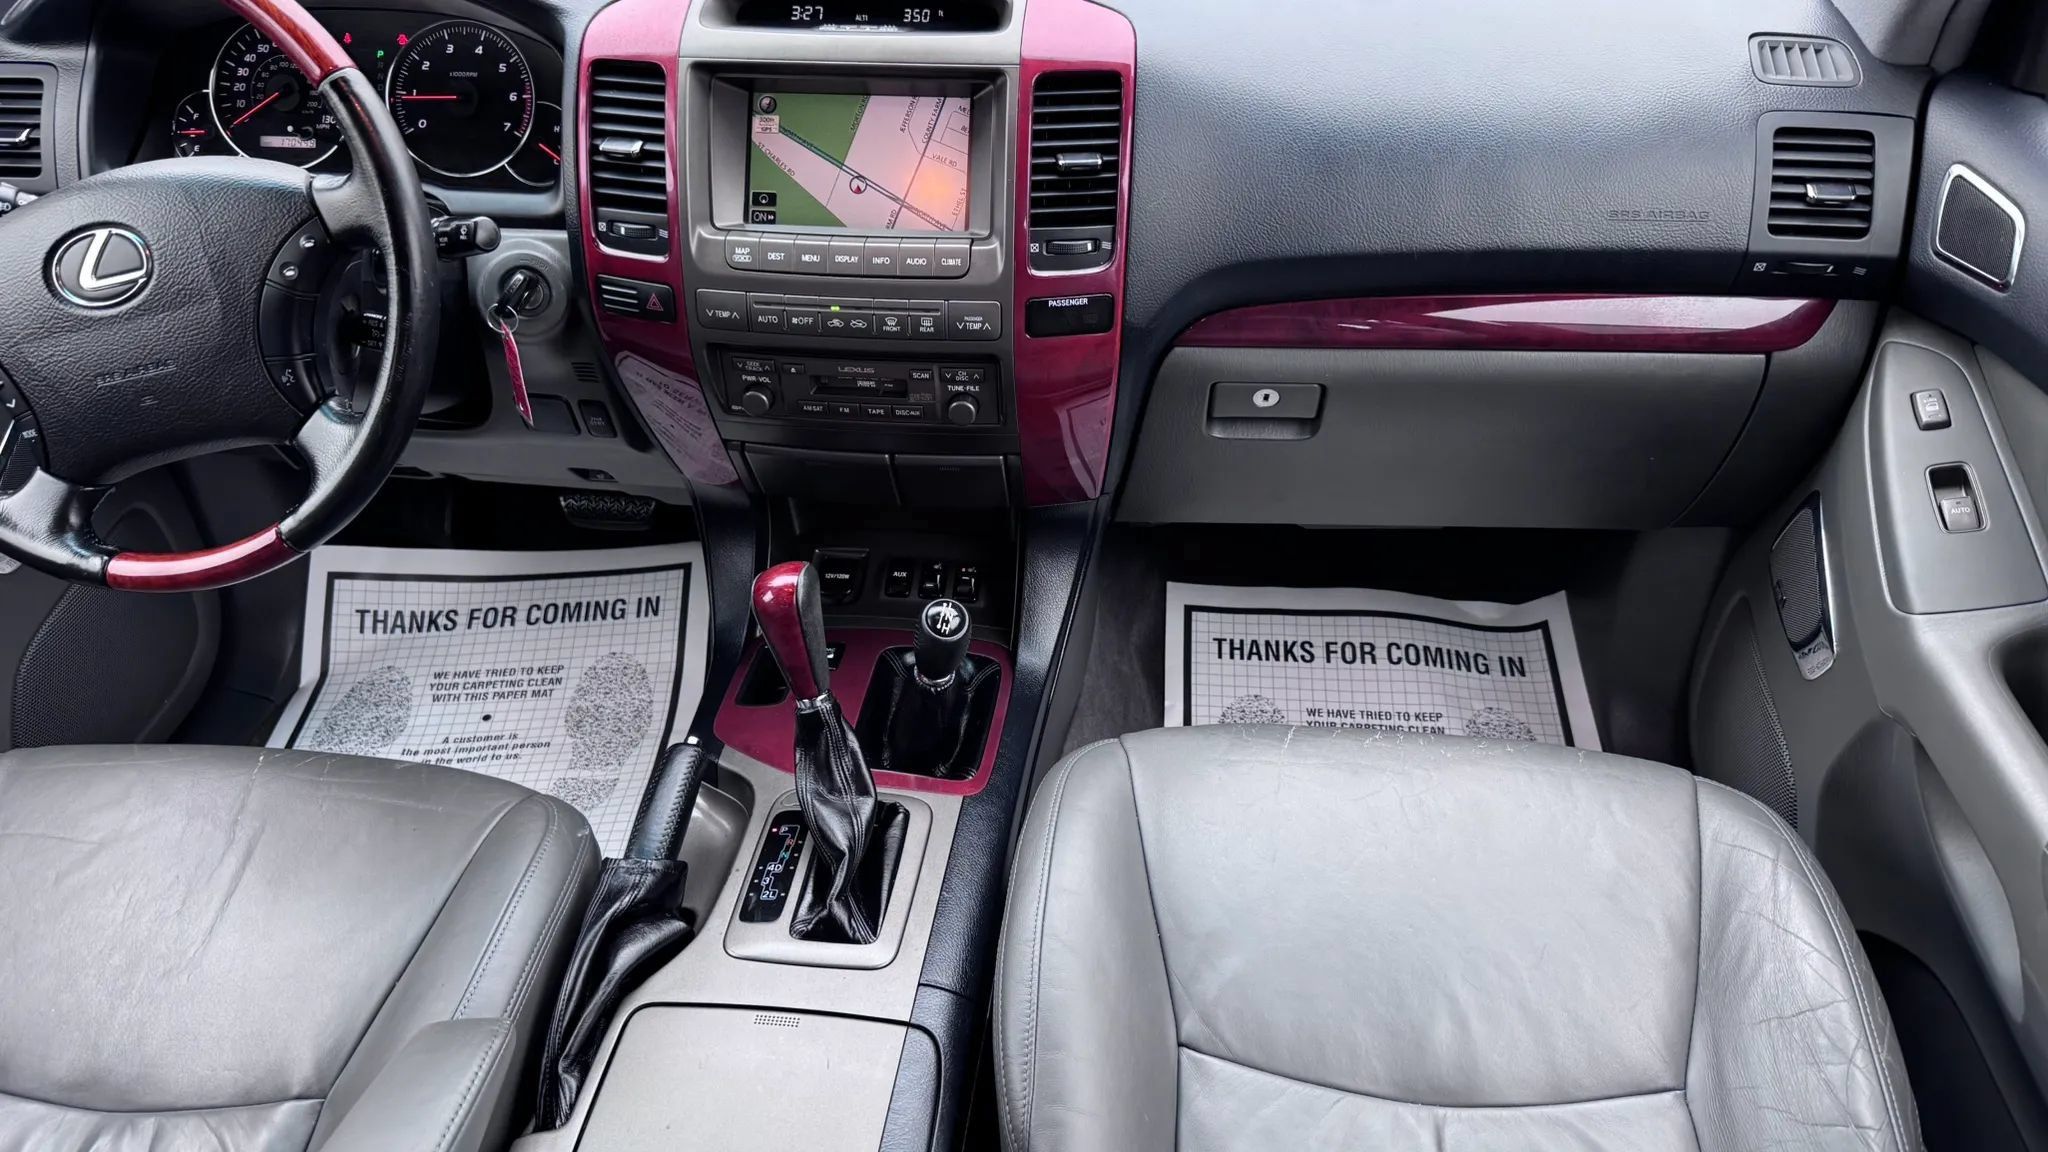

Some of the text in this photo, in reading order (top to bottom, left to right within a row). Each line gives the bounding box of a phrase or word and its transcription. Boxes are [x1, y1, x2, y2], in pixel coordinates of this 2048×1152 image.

[791, 6, 824, 20] 3:27
[903, 9, 930, 22] 350
[257, 44, 270, 53] 50
[446, 44, 454, 54] 3
[474, 46, 484, 54] 4
[244, 54, 256, 62] 40
[376, 50, 384, 58] P
[422, 61, 430, 70] 2
[498, 64, 507, 72] 5
[236, 68, 250, 76] 30
[233, 82, 246, 92] 20
[509, 92, 518, 102] 6
[236, 100, 246, 108] 10
[418, 118, 428, 128] 0
[504, 122, 512, 132] 7
[753, 212, 767, 222] ON
[767, 252, 785, 260] DEST
[801, 254, 820, 262] MENU
[834, 255, 858, 264] DISPLAY
[906, 258, 928, 266] AUDIO
[941, 258, 962, 266] CLIMATE
[1048, 298, 1088, 308] PASSENGER
[715, 310, 732, 318] TEMP
[758, 316, 778, 324] AUTO
[798, 316, 814, 325] OFF
[355, 596, 660, 634] THANKS FOR COMING IN
[1212, 638, 1526, 677] THANKS FOR COMING IN
[433, 665, 564, 680] WE HAVE TRIED TO KEEP
[430, 676, 563, 692] YOUR CARPETING CLEAN
[432, 689, 554, 702] WITH THIS PAPER MAT
[1306, 708, 1444, 722] WE HAVE TRIED TO KEEP
[1408, 726, 1445, 734] CLEAN
[442, 736, 450, 744] A
[454, 734, 505, 744] customer
[401, 742, 551, 756] the most important person
[435, 756, 453, 764] the
[457, 754, 488, 764] world
